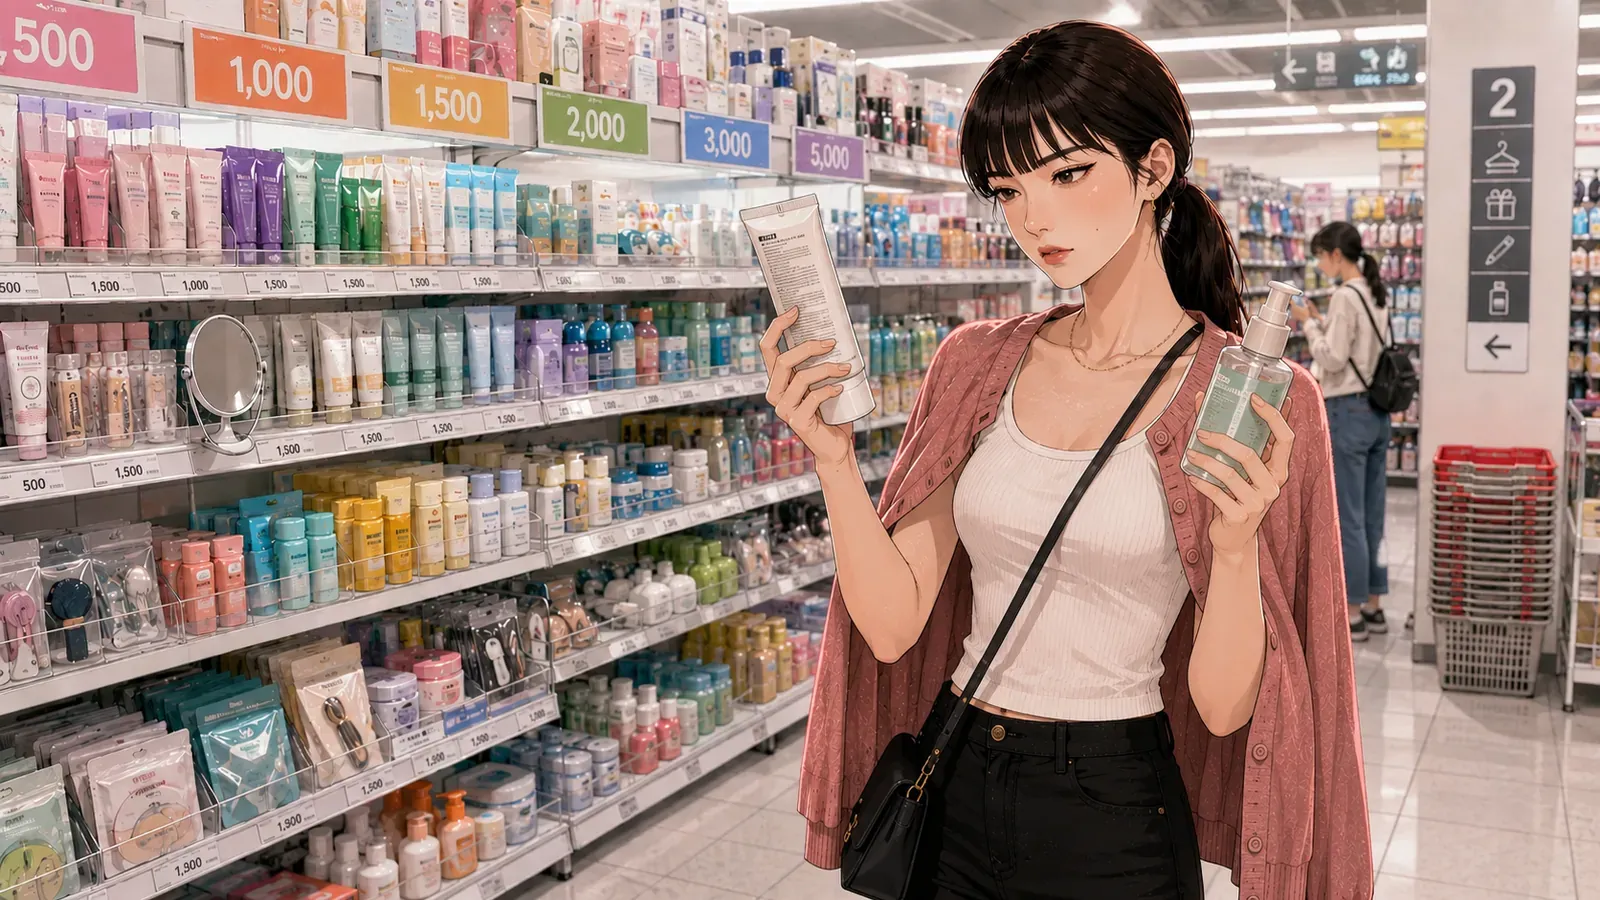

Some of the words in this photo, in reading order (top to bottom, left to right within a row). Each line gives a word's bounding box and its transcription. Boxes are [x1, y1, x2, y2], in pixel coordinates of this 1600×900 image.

[230, 56, 313, 103] 1,000
[415, 84, 482, 124] 1,500
[1489, 77, 1517, 118] 2
[566, 106, 625, 142] 2,000
[703, 127, 752, 159] 3,000
[810, 142, 850, 171] 5,000
[0, 282, 21, 294] 500
[91, 281, 120, 294] 1,500
[182, 280, 209, 292] 1,000
[264, 279, 288, 291] 1,500
[343, 278, 365, 289] 1,500
[410, 277, 430, 288] 1,500
[473, 277, 492, 287] 1,500
[498, 414, 516, 425] 1,500
[433, 422, 453, 434] 1,500
[361, 432, 383, 445] 1,500
[277, 443, 300, 457] 1,500
[115, 465, 143, 479] 1,500
[23, 478, 46, 492] 500
